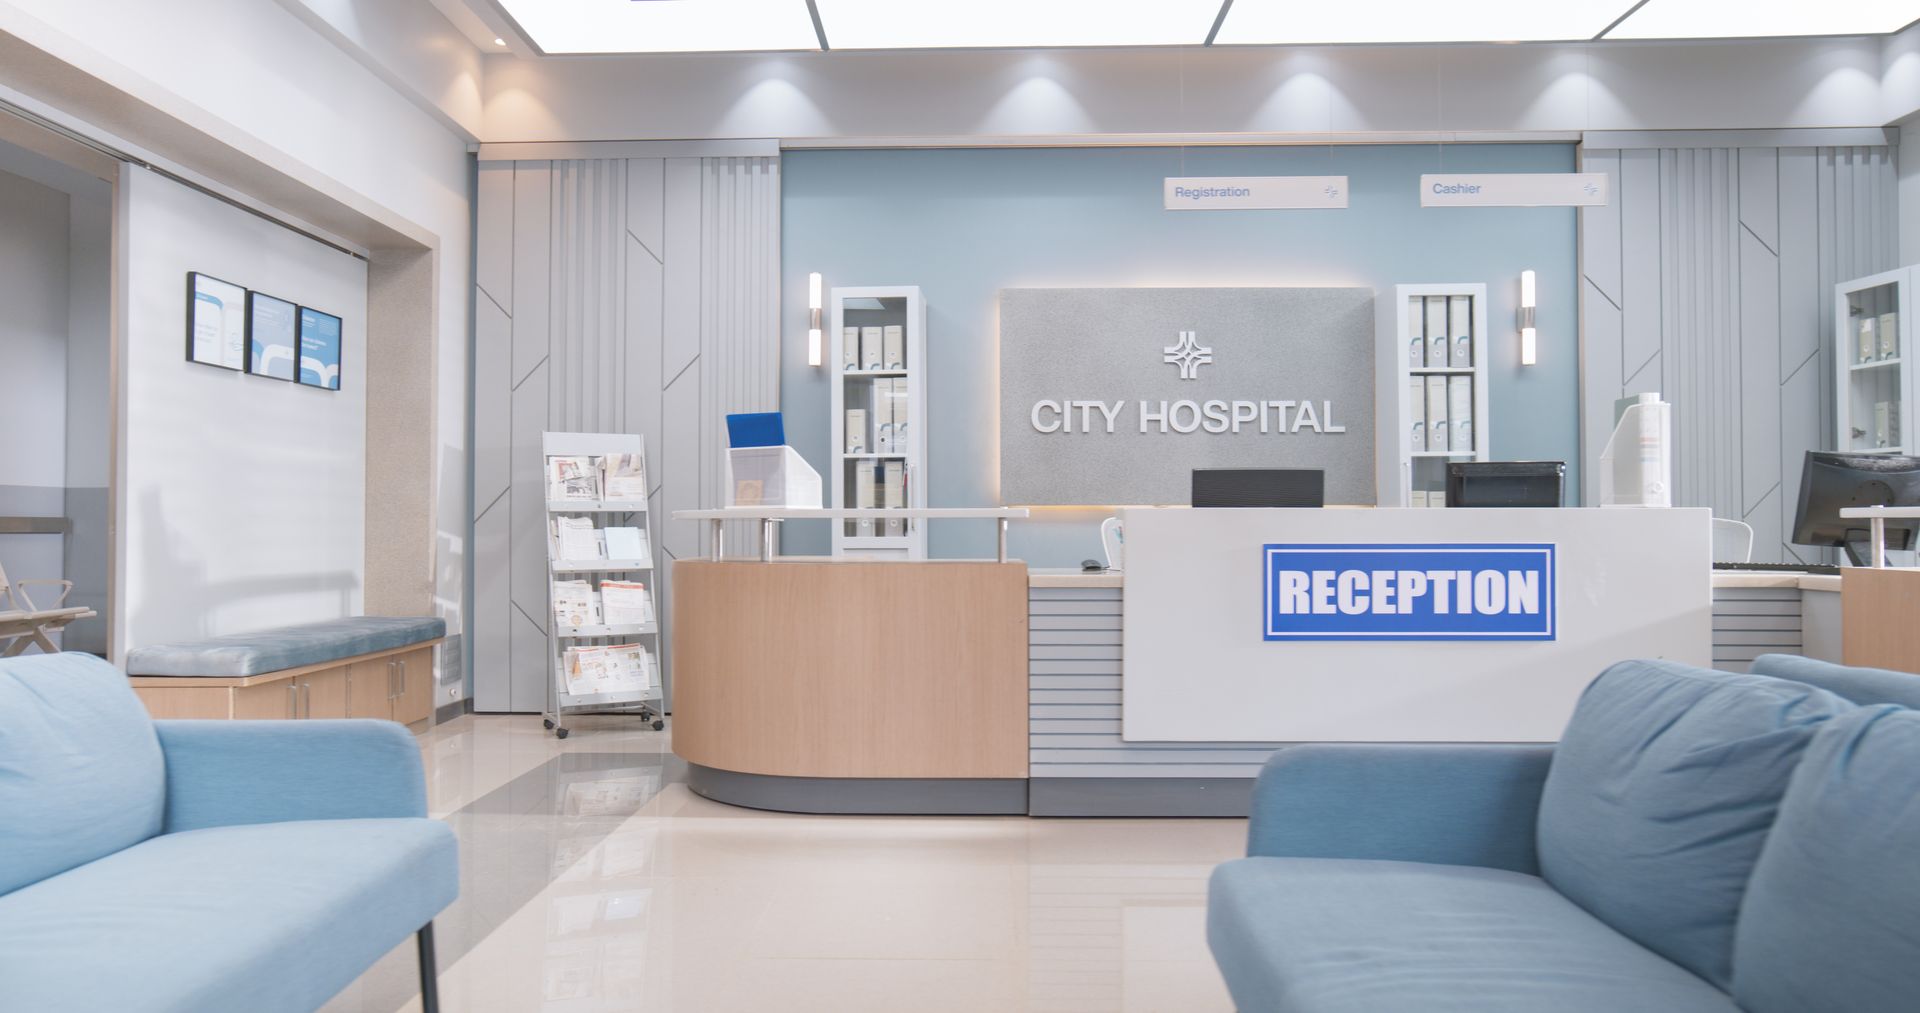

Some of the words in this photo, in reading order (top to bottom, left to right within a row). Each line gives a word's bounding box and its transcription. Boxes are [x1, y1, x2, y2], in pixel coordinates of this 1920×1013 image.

[1175, 186, 1250, 200] Registration
[1432, 183, 1482, 194] Cashier
[1031, 399, 1125, 433] CITY
[1139, 399, 1346, 433] HOSPITAL
[1279, 569, 1539, 615] RECEPTION
